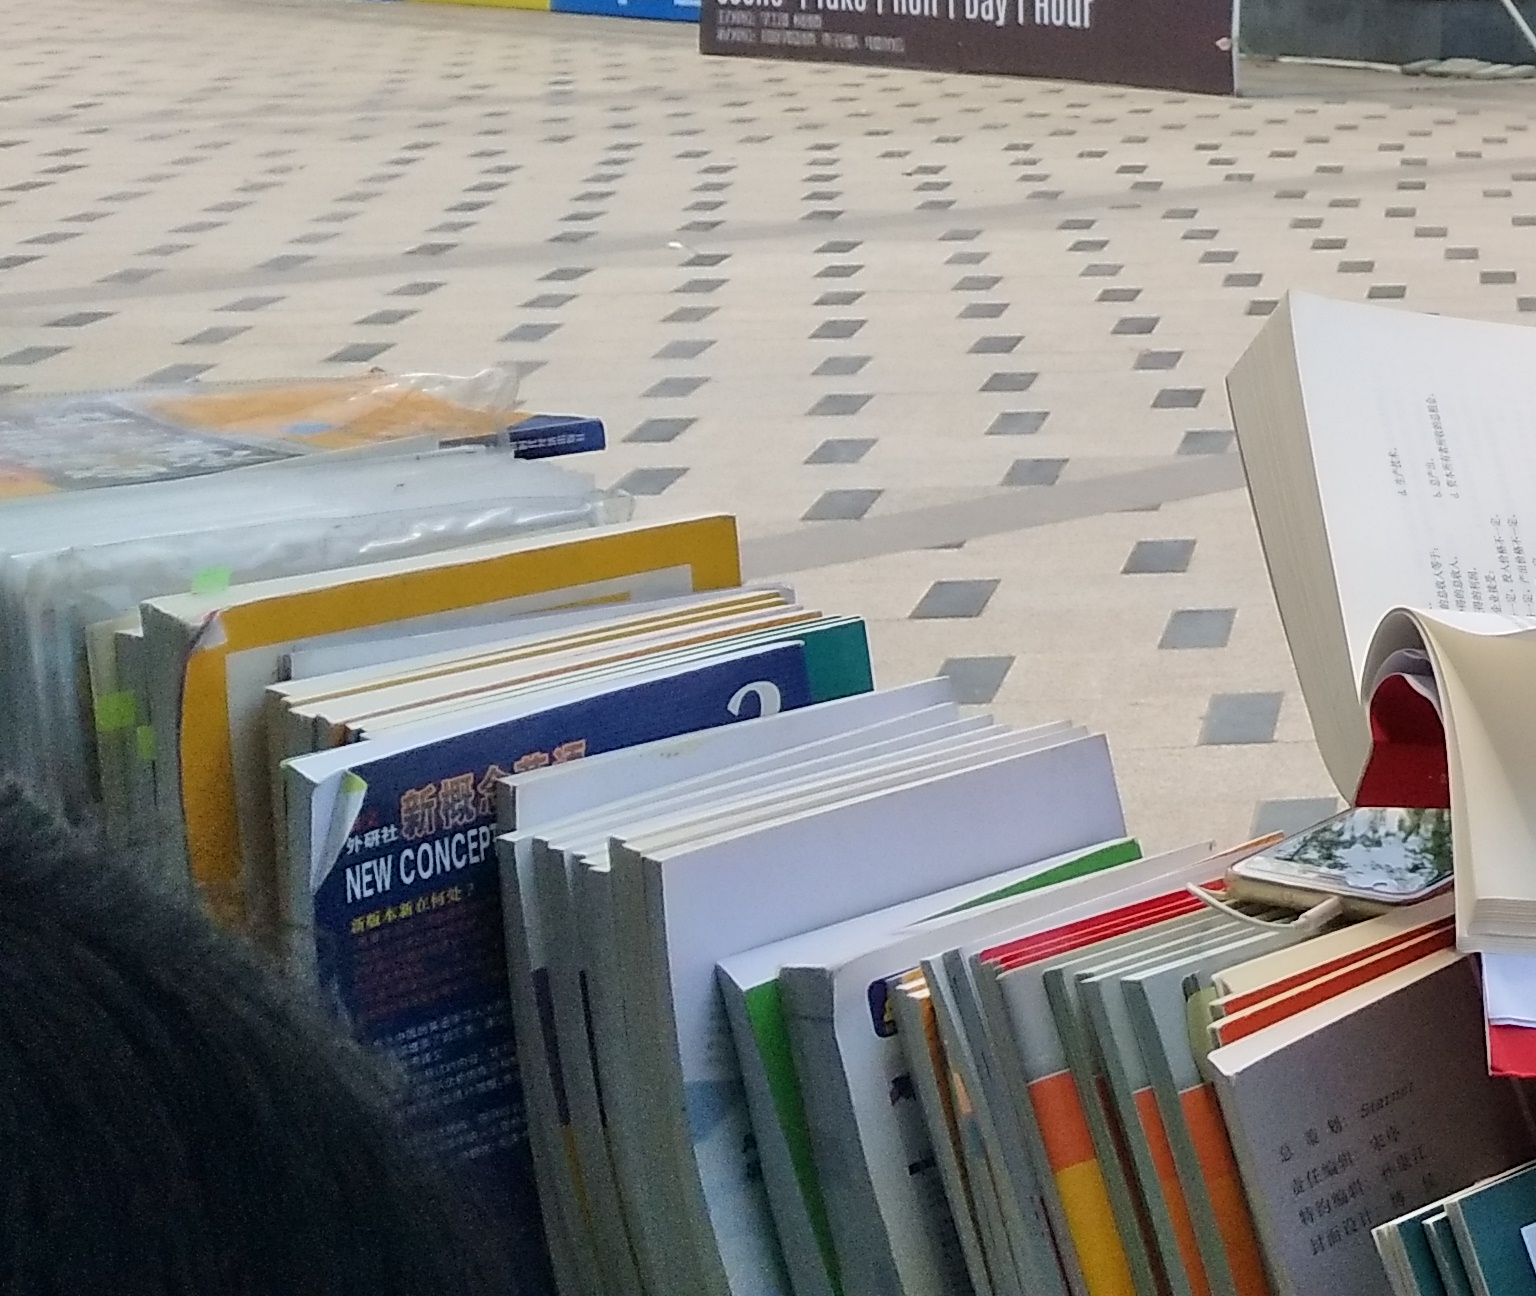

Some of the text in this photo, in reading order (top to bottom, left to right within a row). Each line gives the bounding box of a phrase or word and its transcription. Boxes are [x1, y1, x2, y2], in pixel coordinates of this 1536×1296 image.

[346, 824, 398, 855] 外研社
[346, 855, 393, 903] NEW
